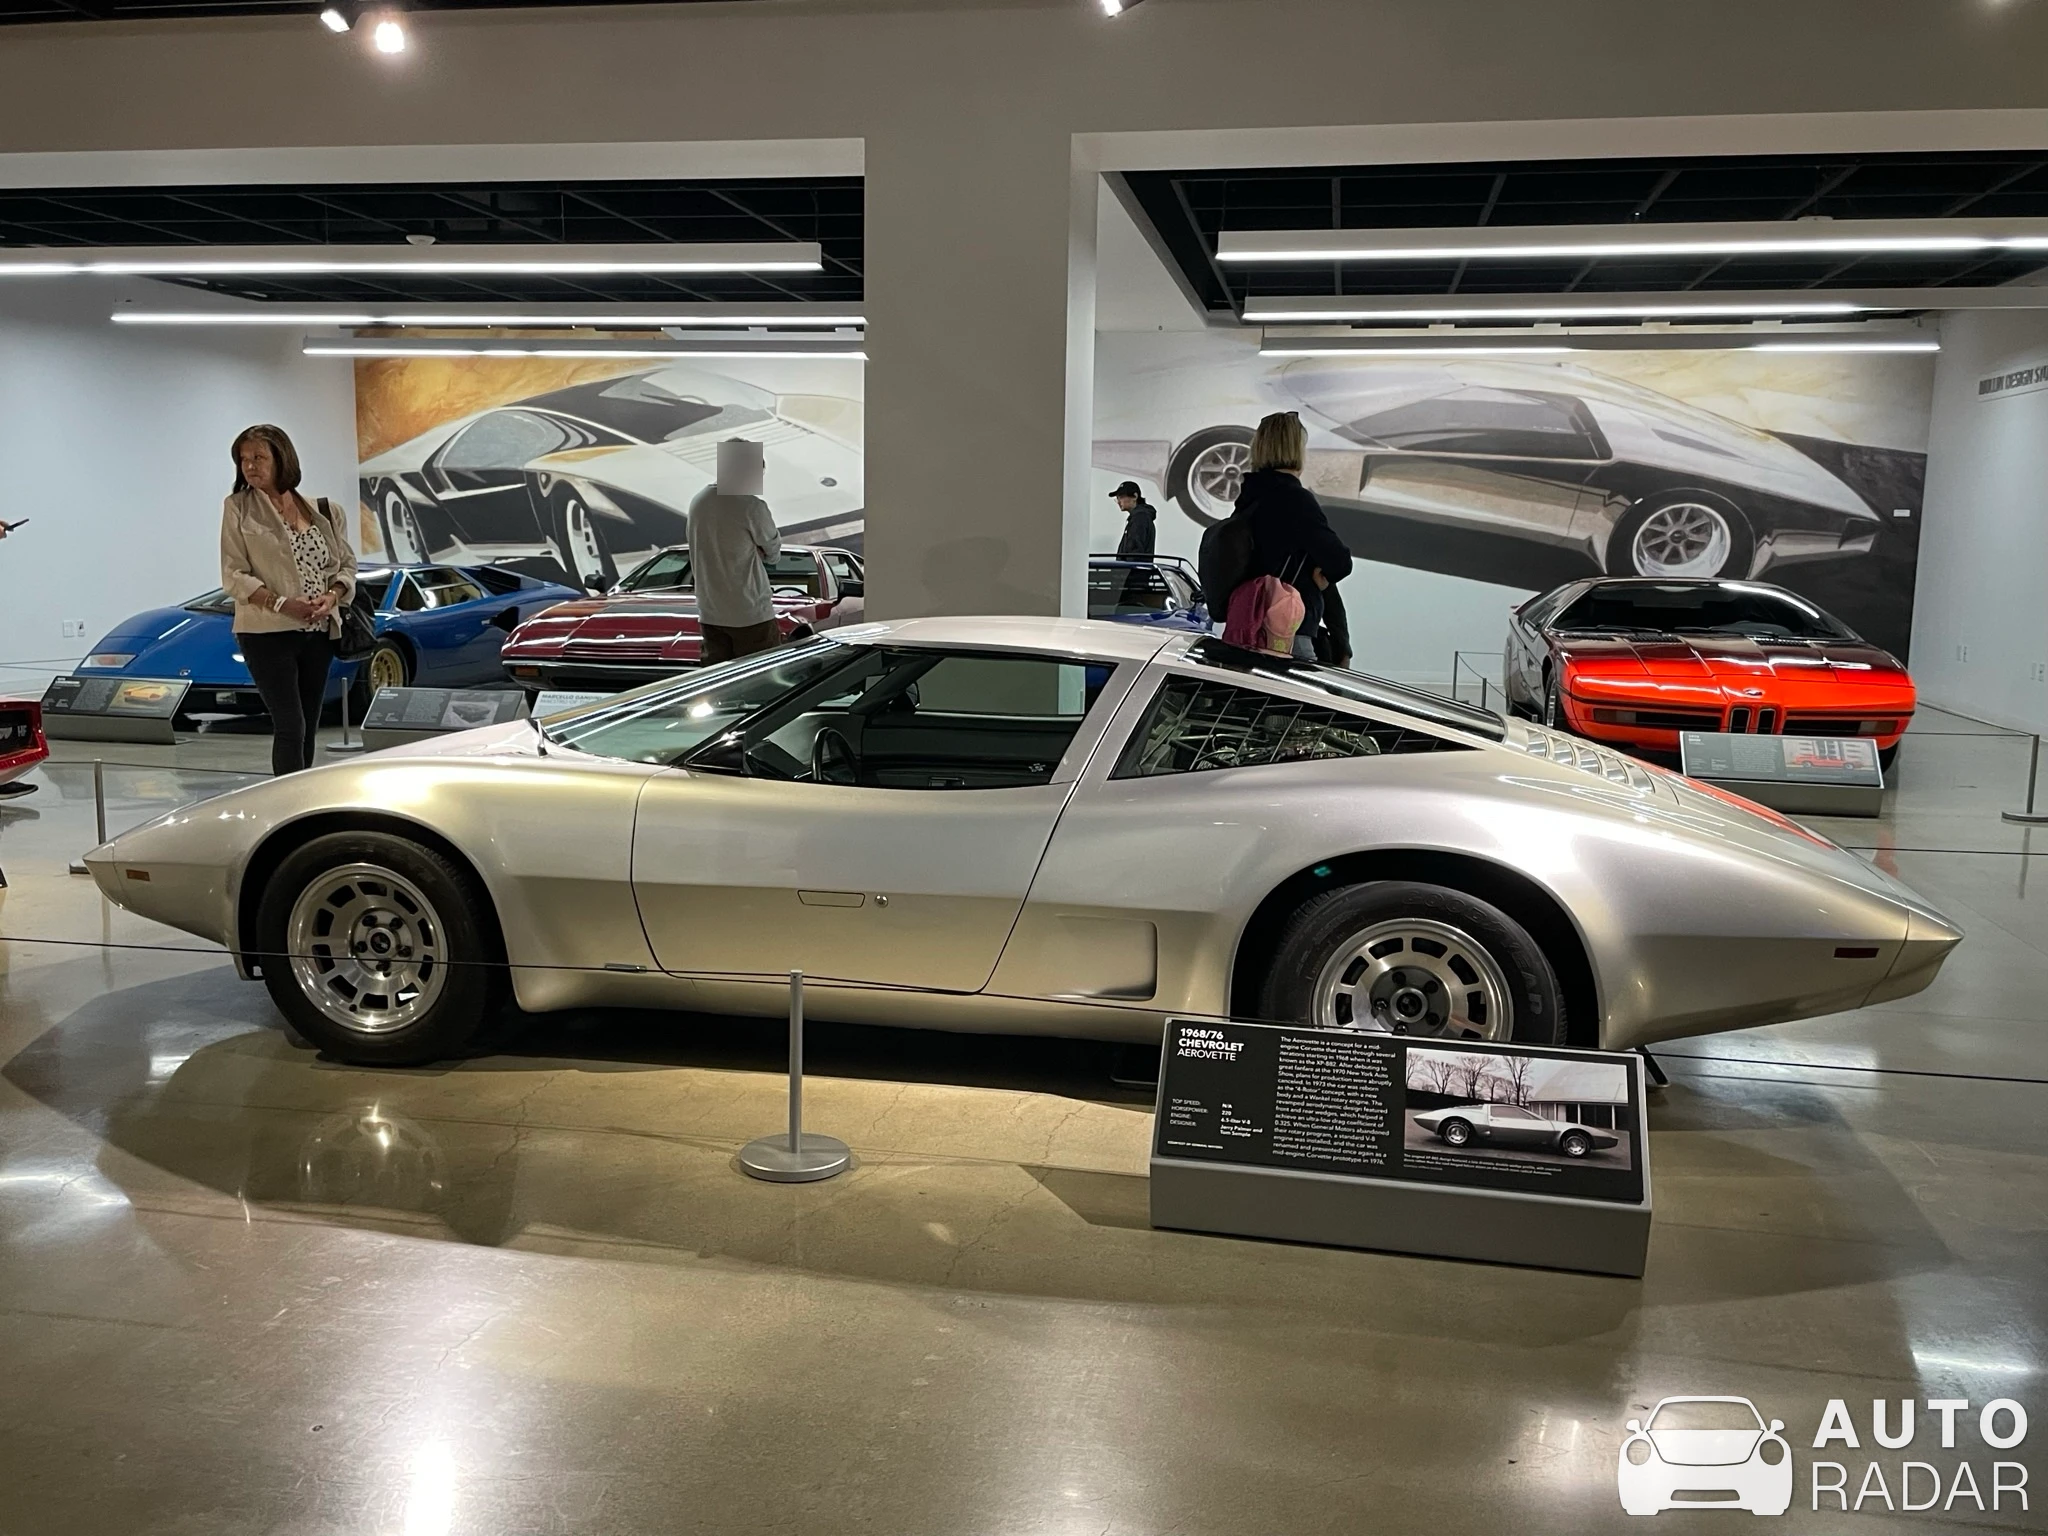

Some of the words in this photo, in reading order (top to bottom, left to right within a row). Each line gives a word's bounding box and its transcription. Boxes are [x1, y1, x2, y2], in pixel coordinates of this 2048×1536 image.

[1180, 1028, 1224, 1040] 1968/76
[1178, 1038, 1244, 1052] CHEVROLET
[1177, 1048, 1236, 1061] AEROVETTE
[1321, 1075, 1352, 1083] production
[1276, 1099, 1305, 1107] revamped
[1306, 1102, 1342, 1111] aerodynamic
[1312, 1146, 1341, 1154] presented
[1332, 1155, 1361, 1164] prototype
